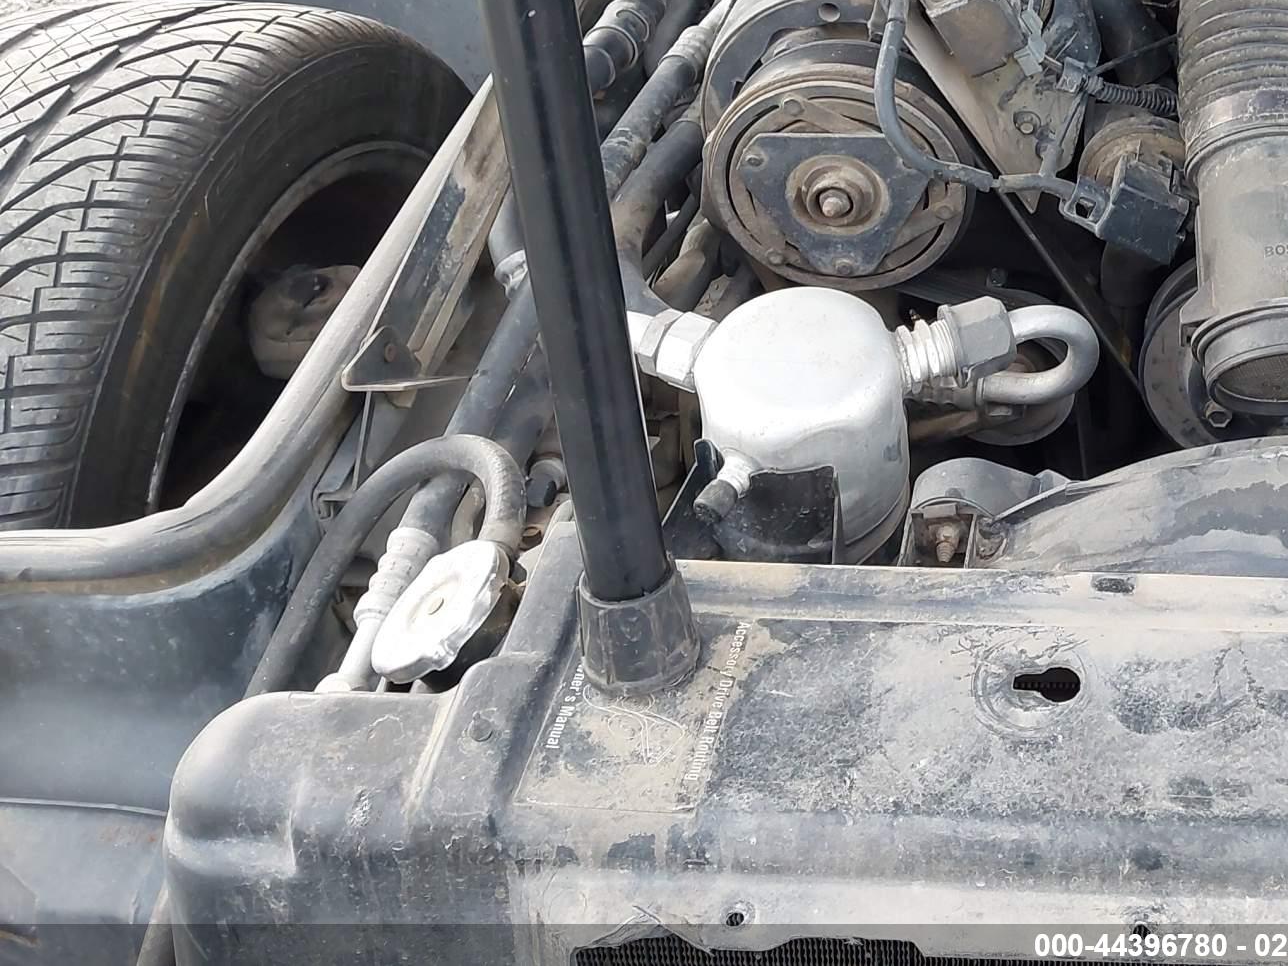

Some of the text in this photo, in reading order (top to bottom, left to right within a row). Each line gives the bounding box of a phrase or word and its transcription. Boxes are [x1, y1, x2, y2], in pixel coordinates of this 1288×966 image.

[545, 664, 585, 749] wner's Manual
[684, 621, 751, 781] Accessory Drive Belt Routing
